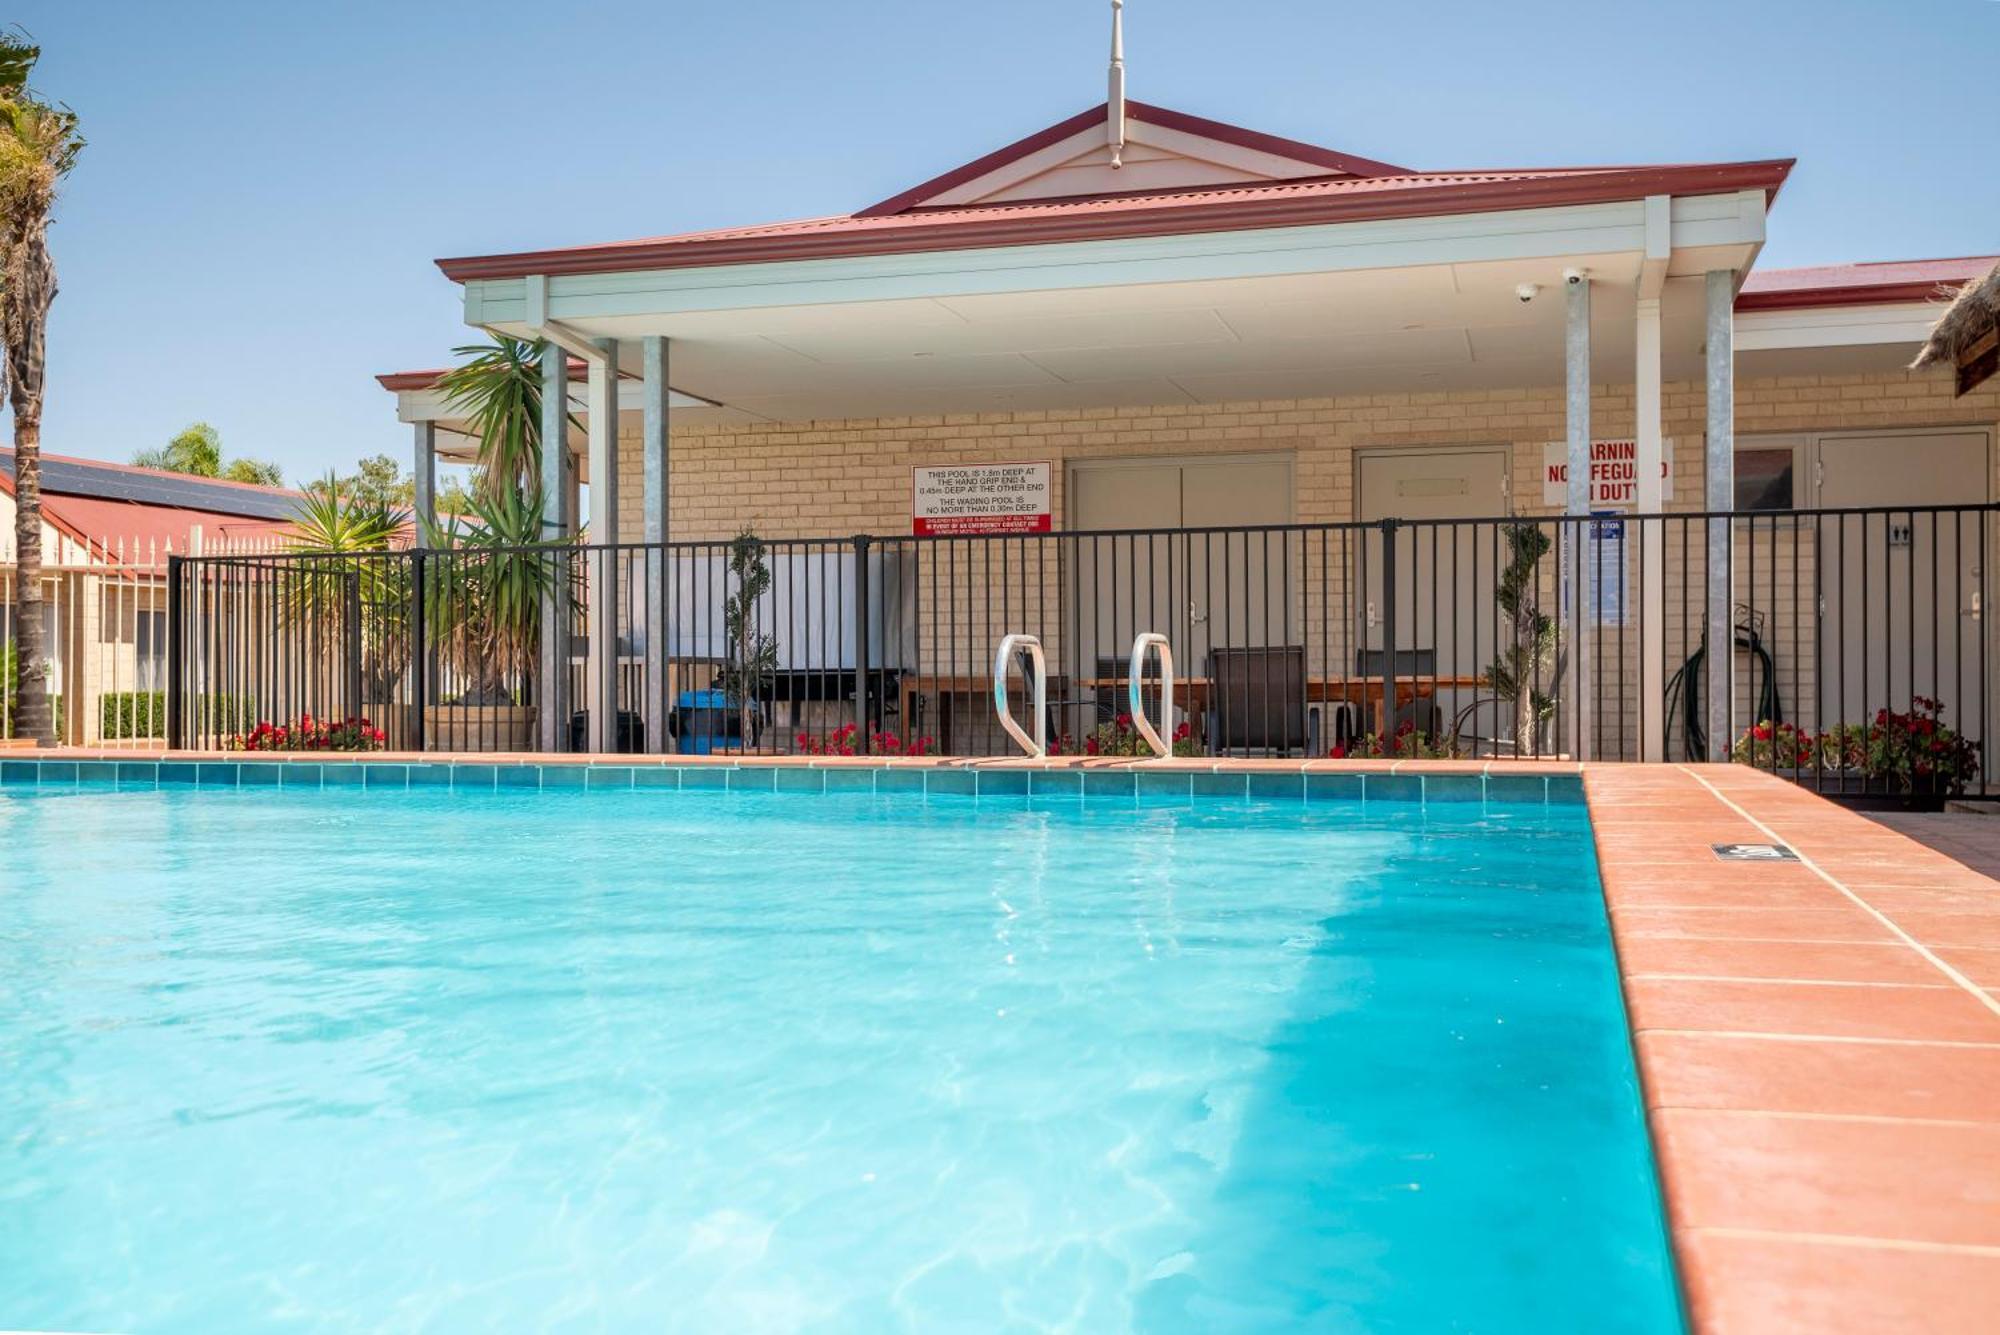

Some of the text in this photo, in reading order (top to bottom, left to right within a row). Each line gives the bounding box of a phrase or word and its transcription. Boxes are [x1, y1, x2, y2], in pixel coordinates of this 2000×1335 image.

[1590, 444, 1635, 460] RNIN
[948, 470, 969, 478] POOL
[1002, 468, 1024, 476] DEEP
[1026, 467, 1036, 475] AT
[937, 475, 1026, 486] THE HAND GRIP END &
[944, 486, 966, 494] DEEP
[979, 485, 995, 493] THE
[997, 484, 1025, 492] OTHER
[1027, 483, 1044, 491] END
[940, 495, 1025, 506] THE WADING POOL IS
[940, 506, 964, 514] MORE
[1016, 504, 1038, 512] DEEP
